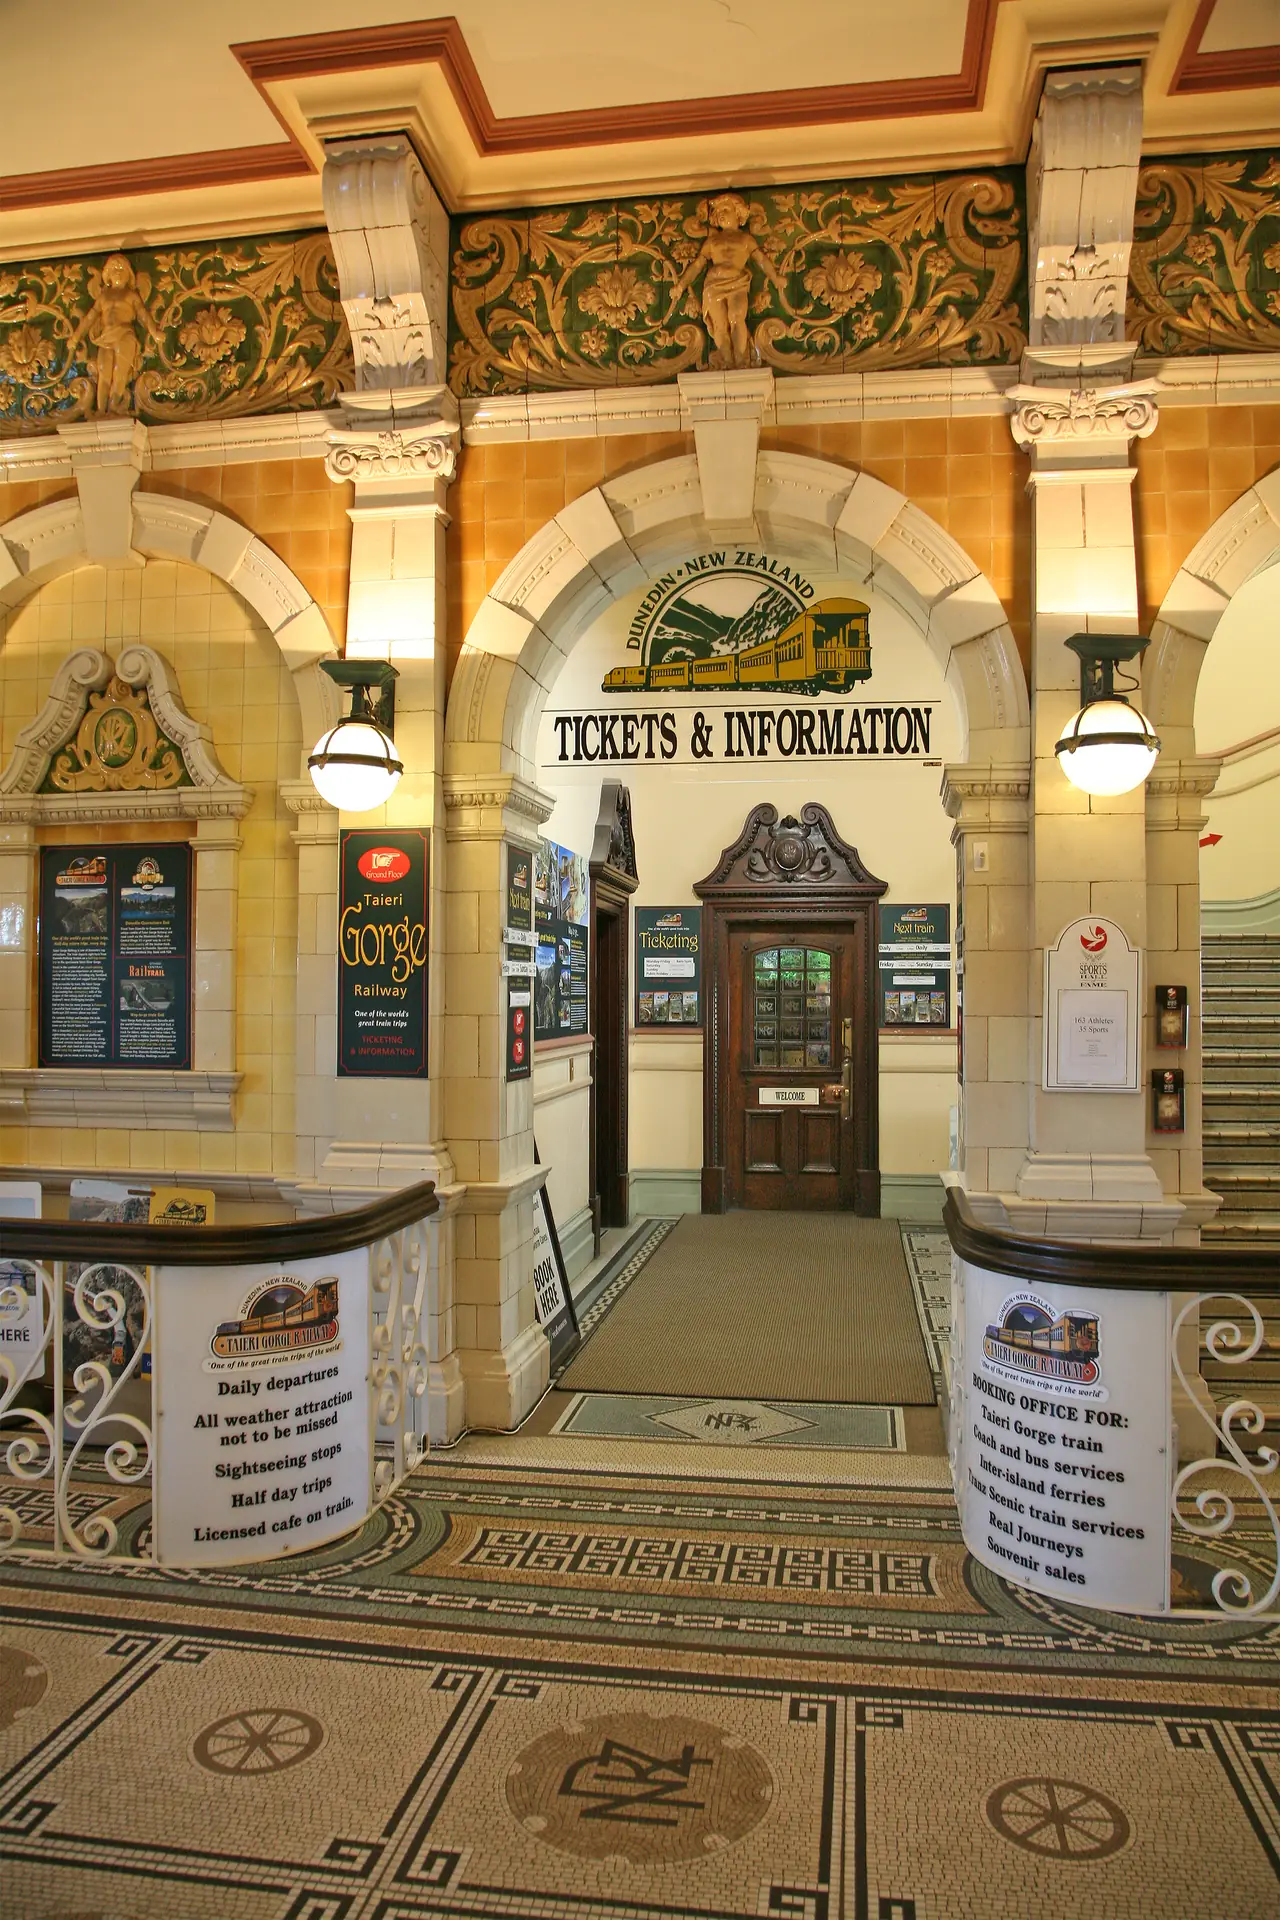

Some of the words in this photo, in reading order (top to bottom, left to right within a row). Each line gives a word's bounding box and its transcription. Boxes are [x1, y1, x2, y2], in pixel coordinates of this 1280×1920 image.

[626, 572, 678, 651] DUNEDIN
[684, 551, 726, 576] NEW
[733, 551, 815, 600] ZEALAND
[554, 712, 678, 761] TICKETS
[691, 711, 713, 759] &
[724, 706, 932, 757] INFORMATION
[366, 870, 387, 879] Ground
[388, 870, 403, 878] Floor
[363, 893, 402, 906] Taieri
[339, 902, 427, 983] Gorge
[639, 931, 698, 952] Ticketing
[893, 922, 912, 934] Next
[914, 922, 935, 934] train
[1079, 964, 1107, 975] SPORTS
[354, 983, 407, 1000] Railway
[358, 1019, 374, 1028] great
[392, 1020, 407, 1028] trips
[368, 1010, 376, 1018] of
[387, 1010, 409, 1018] world's
[1088, 1026, 1109, 1034] Sports
[358, 1047, 415, 1056] INFORMATION
[361, 1035, 403, 1044] TICKETING
[775, 1091, 806, 1101] WELCOME
[533, 1256, 555, 1293] BOOK
[240, 1286, 262, 1315] DUNEDIN
[265, 1278, 280, 1287] NEW
[282, 1276, 308, 1291] ZEALAND
[539, 1281, 560, 1319] HERE
[998, 1297, 1014, 1322] DUNEDIN
[1015, 1293, 1028, 1301] NEW
[1029, 1295, 1056, 1317] ZEALAND
[226, 1335, 259, 1353] TAIERI
[261, 1333, 292, 1349] GORGE
[293, 1325, 330, 1344] RAILWAY
[227, 1361, 235, 1369] of
[237, 1360, 249, 1368] the
[251, 1357, 270, 1368] great
[271, 1356, 289, 1364] train
[290, 1352, 306, 1361] trips
[307, 1350, 315, 1358] of
[315, 1348, 324, 1356] the
[990, 1341, 1011, 1362] TAIERI
[1012, 1348, 1039, 1370] GORGE
[1041, 1357, 1084, 1379] RAILWAY
[217, 1381, 261, 1396] Daily
[266, 1365, 339, 1391] departures
[990, 1365, 996, 1373] of
[996, 1366, 1004, 1375] the
[1004, 1370, 1019, 1381] great
[1020, 1373, 1036, 1386] train
[1036, 1378, 1053, 1390] trips
[1054, 1382, 1063, 1391] of
[1064, 1383, 1076, 1393] the
[193, 1413, 219, 1429] All
[224, 1408, 290, 1426] weather
[294, 1390, 353, 1417] attraction
[972, 1372, 1016, 1406] BOOKING
[1019, 1395, 1078, 1422] OFFICE
[1084, 1409, 1129, 1428] FOR:
[220, 1431, 247, 1446] not
[252, 1430, 269, 1443] to
[274, 1426, 291, 1440] be
[296, 1411, 338, 1435] missed
[981, 1404, 1010, 1431] Taieri
[1013, 1420, 1056, 1446] Gorge
[1061, 1433, 1104, 1453] train
[215, 1454, 307, 1480] Sightseeing
[311, 1442, 342, 1462] stops
[973, 1424, 996, 1450] Coach
[1000, 1442, 1021, 1461] and
[1025, 1449, 1050, 1469] bus
[1054, 1461, 1125, 1483] services
[231, 1490, 267, 1508] Half
[270, 1486, 299, 1502] day
[302, 1476, 332, 1495] trips
[979, 1453, 1045, 1495] Inter-island
[1050, 1483, 1106, 1508] ferries
[193, 1520, 267, 1542] Licensed
[271, 1514, 302, 1533] cafe
[306, 1511, 322, 1524] on
[325, 1495, 354, 1517] train.
[968, 1467, 987, 1495] Tranz
[988, 1485, 1025, 1515] Scenic
[1029, 1504, 1067, 1527] train
[1071, 1517, 1145, 1540] services
[989, 1510, 1014, 1536] Real
[1016, 1524, 1084, 1559] Journeys
[987, 1535, 1040, 1572] Souvenir
[1045, 1564, 1087, 1585] sales
